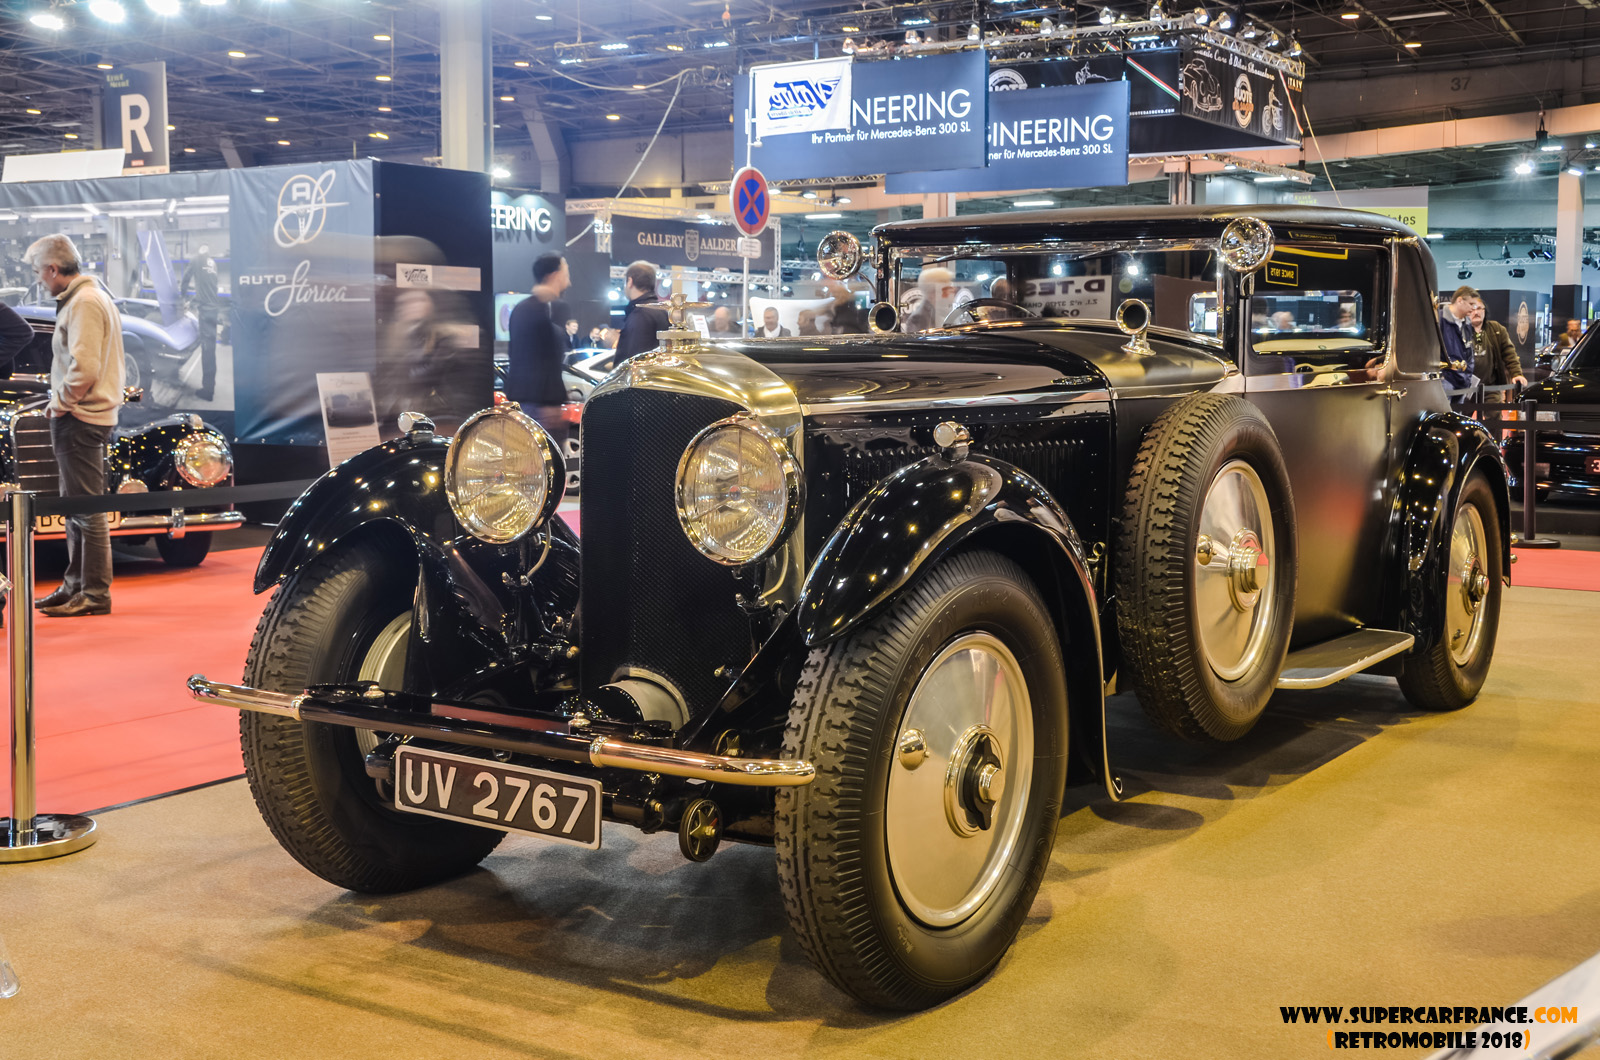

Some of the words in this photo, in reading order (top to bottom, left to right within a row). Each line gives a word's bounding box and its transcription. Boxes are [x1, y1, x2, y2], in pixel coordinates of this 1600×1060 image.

[1450, 77, 1472, 91] 37
[121, 93, 153, 154] R
[852, 88, 972, 127] NEERING
[811, 133, 823, 144] Ihr
[825, 130, 854, 143] Partner
[856, 128, 869, 141] für
[870, 125, 937, 140] Mercedes-Benz
[938, 122, 958, 135] 300
[960, 121, 971, 132] SL
[988, 114, 1114, 147] INEERING
[1003, 149, 1016, 159] für
[1017, 146, 1081, 159] Mercedes-Benz
[1082, 145, 1101, 155] 300
[1102, 143, 1113, 154] SL
[637, 231, 685, 249] GALLERY
[700, 237, 737, 252] AALDER
[239, 274, 287, 285] AUTO
[264, 259, 371, 317] Storica
[405, 758, 457, 810] UV
[472, 771, 589, 834] 2767
